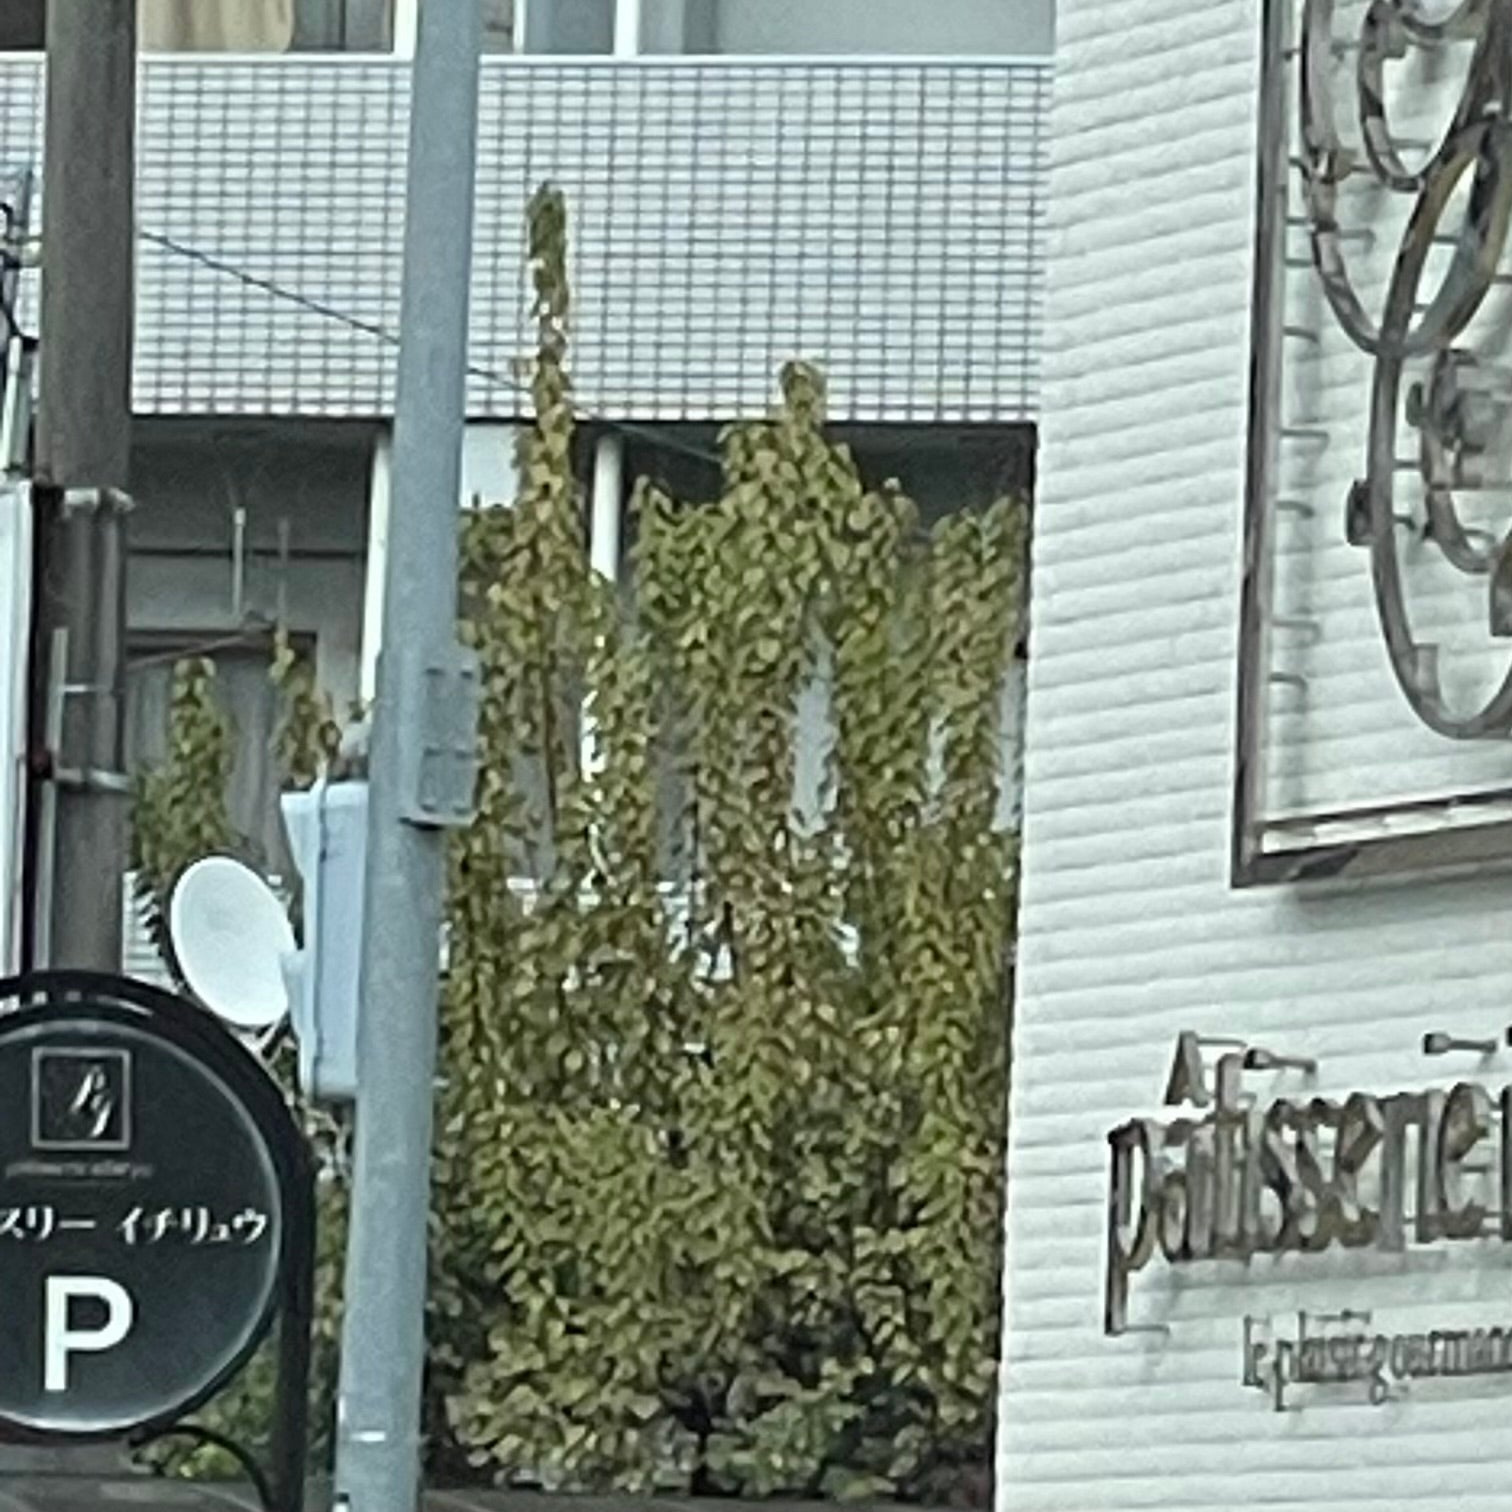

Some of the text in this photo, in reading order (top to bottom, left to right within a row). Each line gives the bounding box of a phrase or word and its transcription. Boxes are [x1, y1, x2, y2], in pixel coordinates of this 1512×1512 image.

[116, 1207, 266, 1245] イチリュウ
[45, 1276, 133, 1390] P
